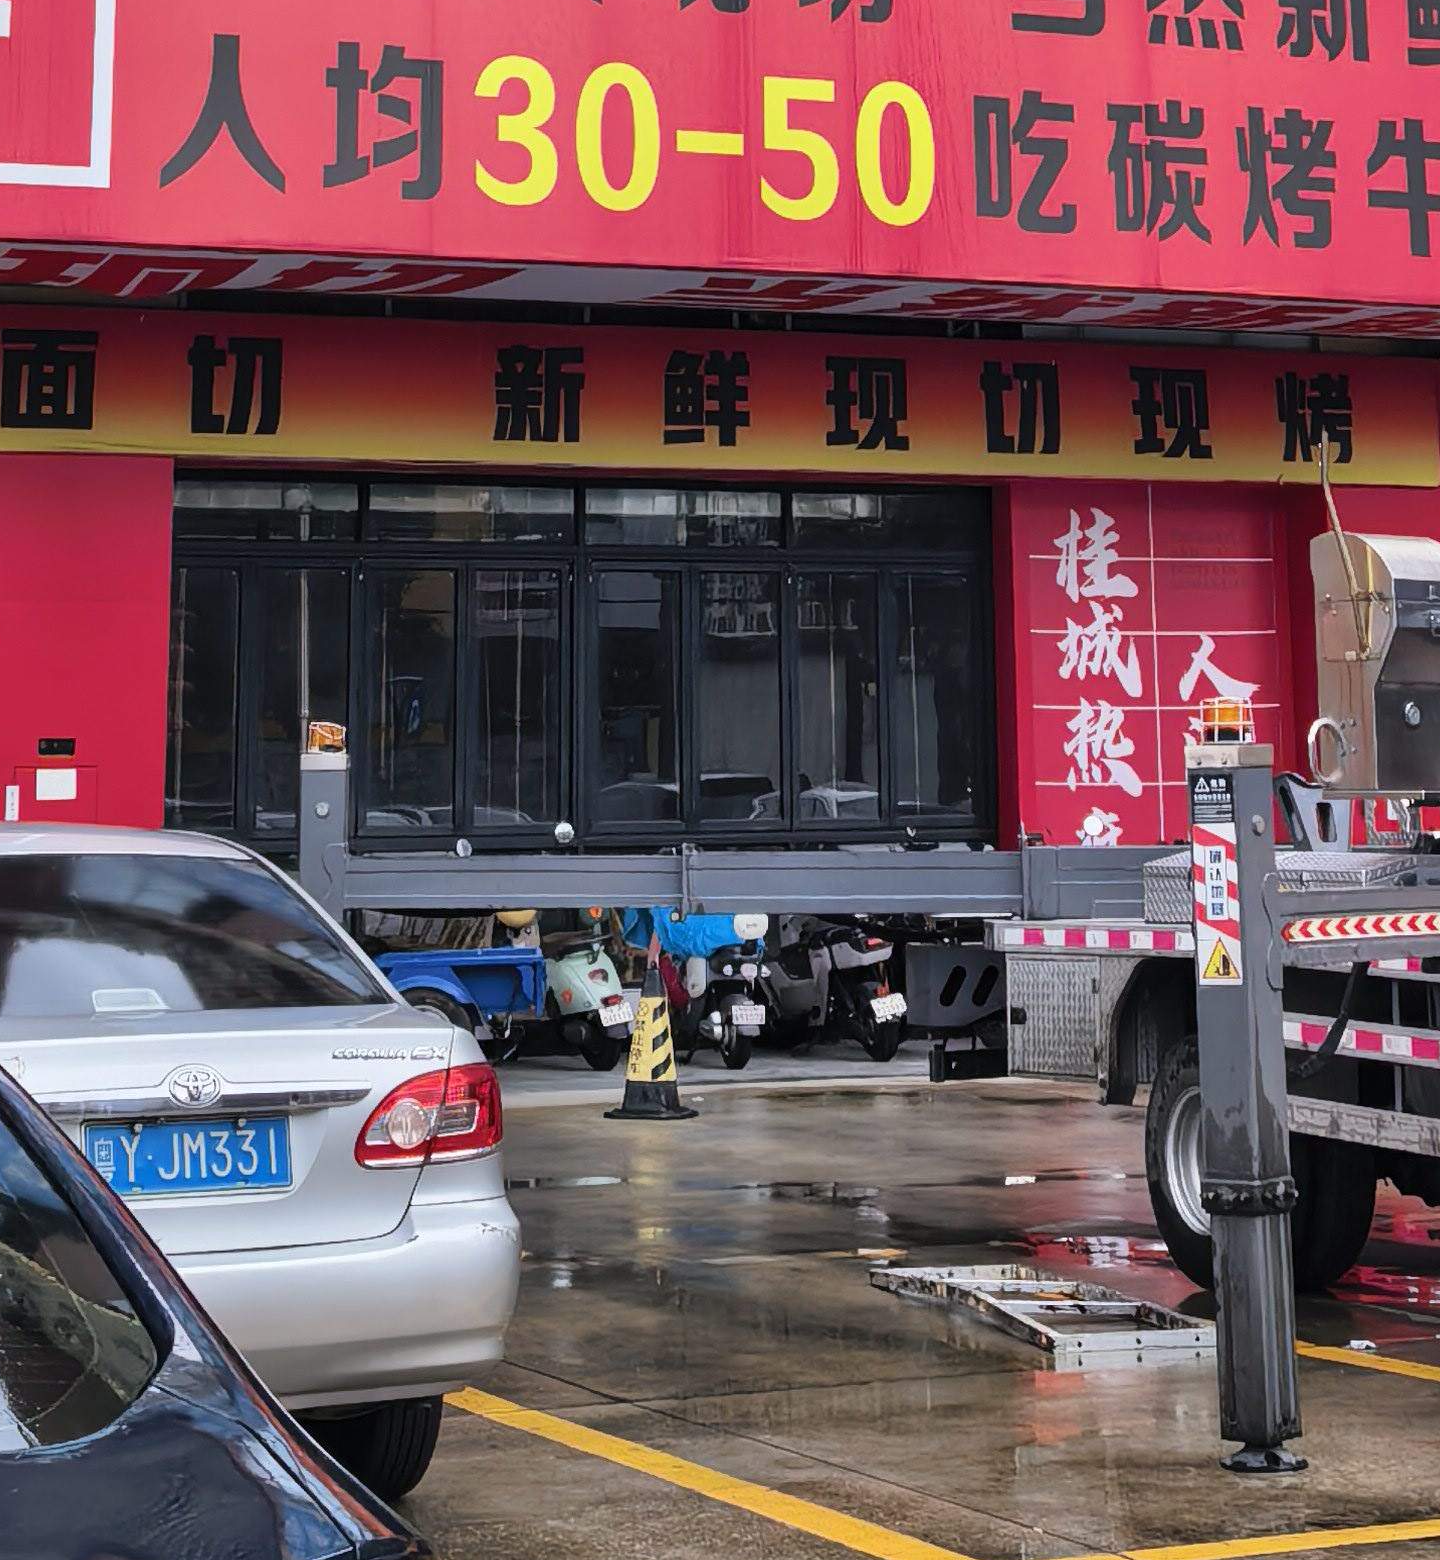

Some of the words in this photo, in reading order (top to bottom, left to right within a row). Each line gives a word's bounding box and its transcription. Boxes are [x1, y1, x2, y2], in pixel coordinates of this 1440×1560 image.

[493, 344, 1354, 468] 新鲜现切现烤
